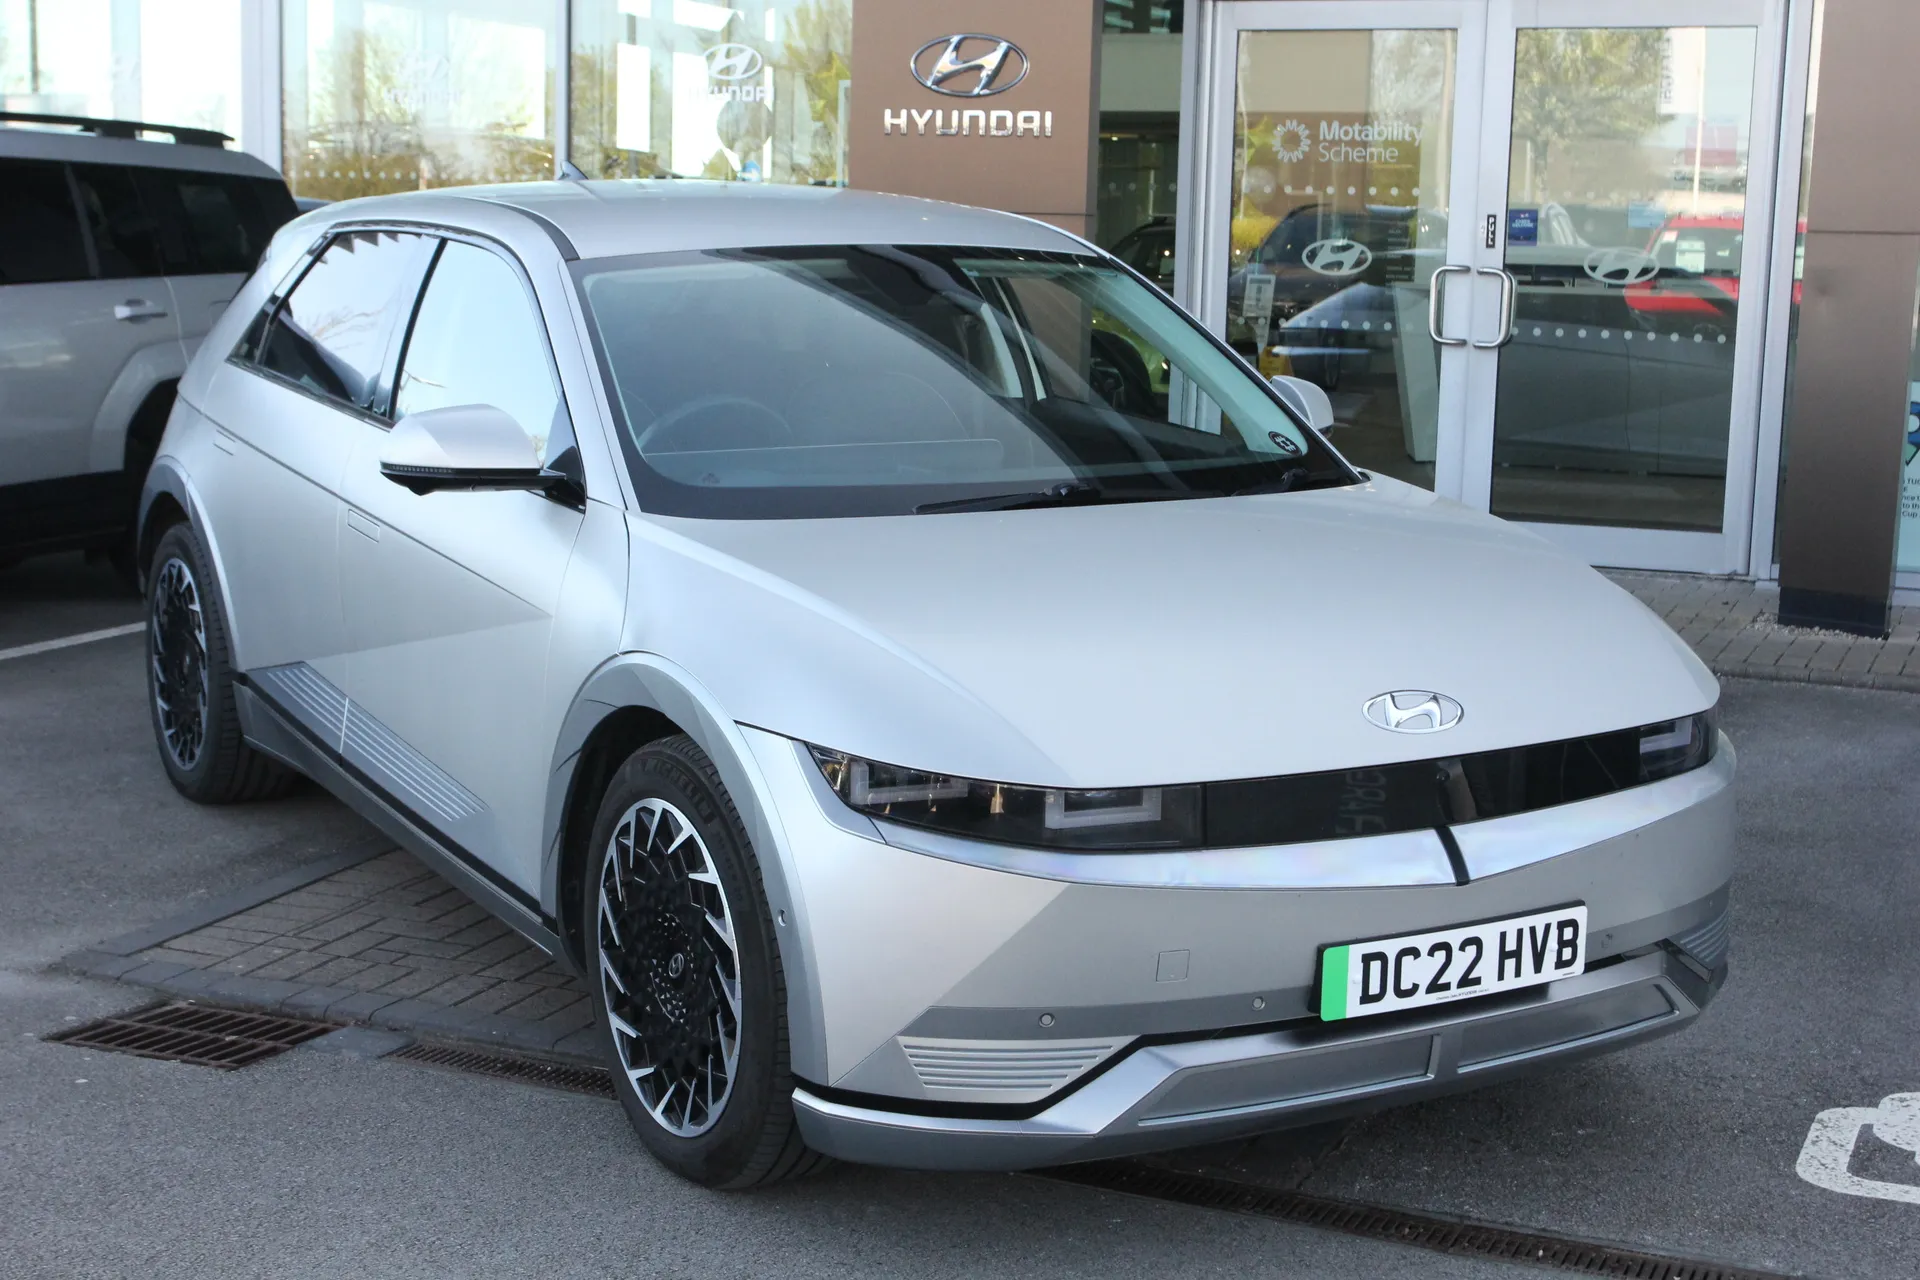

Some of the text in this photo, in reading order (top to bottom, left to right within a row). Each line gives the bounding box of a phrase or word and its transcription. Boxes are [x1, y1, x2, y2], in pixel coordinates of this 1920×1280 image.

[884, 108, 1052, 137] HYUNDAI
[1319, 120, 1424, 147] Motability
[1318, 142, 1398, 163] Scheme
[1359, 918, 1579, 1005] DC22 HVB
